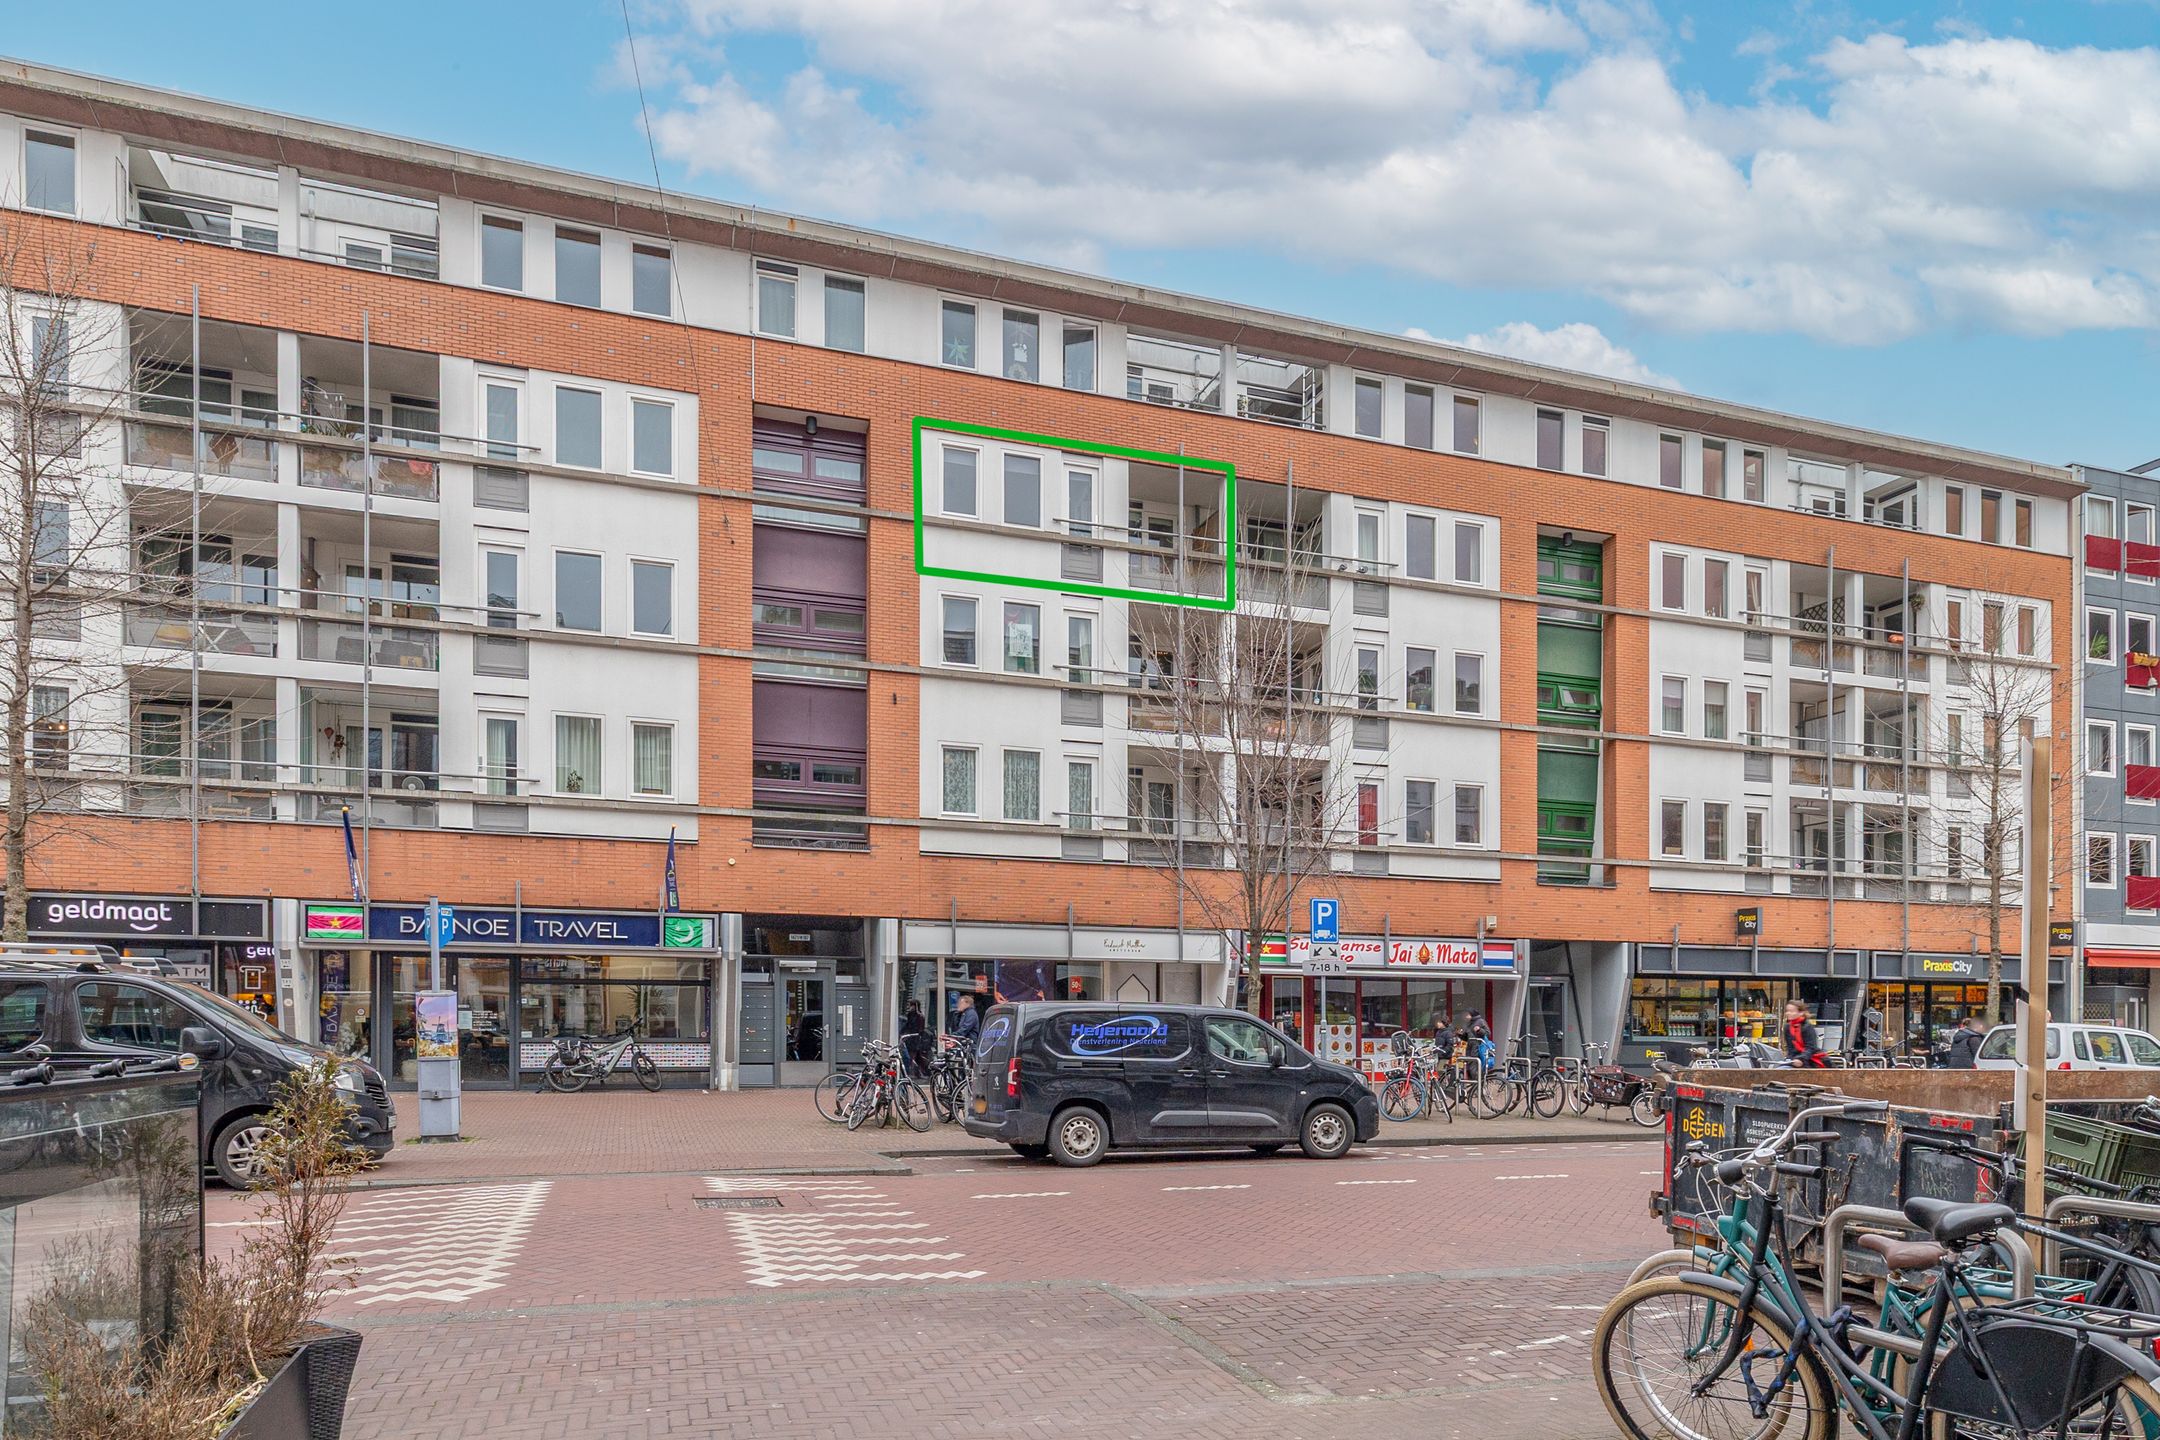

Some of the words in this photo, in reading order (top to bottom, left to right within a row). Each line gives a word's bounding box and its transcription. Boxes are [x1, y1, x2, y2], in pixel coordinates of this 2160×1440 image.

[48, 900, 172, 923] geldmaat
[1317, 902, 1332, 925] P
[400, 906, 509, 936] BNOE
[534, 919, 628, 939] TRAVEL
[441, 918, 449, 935] P
[1290, 937, 1382, 953] Suamse
[2058, 933, 2073, 941] City
[1388, 942, 1413, 964] Jai
[1436, 943, 1477, 964] Mata
[172, 967, 206, 977] TM
[1310, 963, 1331, 973] 7-18
[1334, 963, 1341, 973] h
[1923, 959, 1973, 975] PraxisCity
